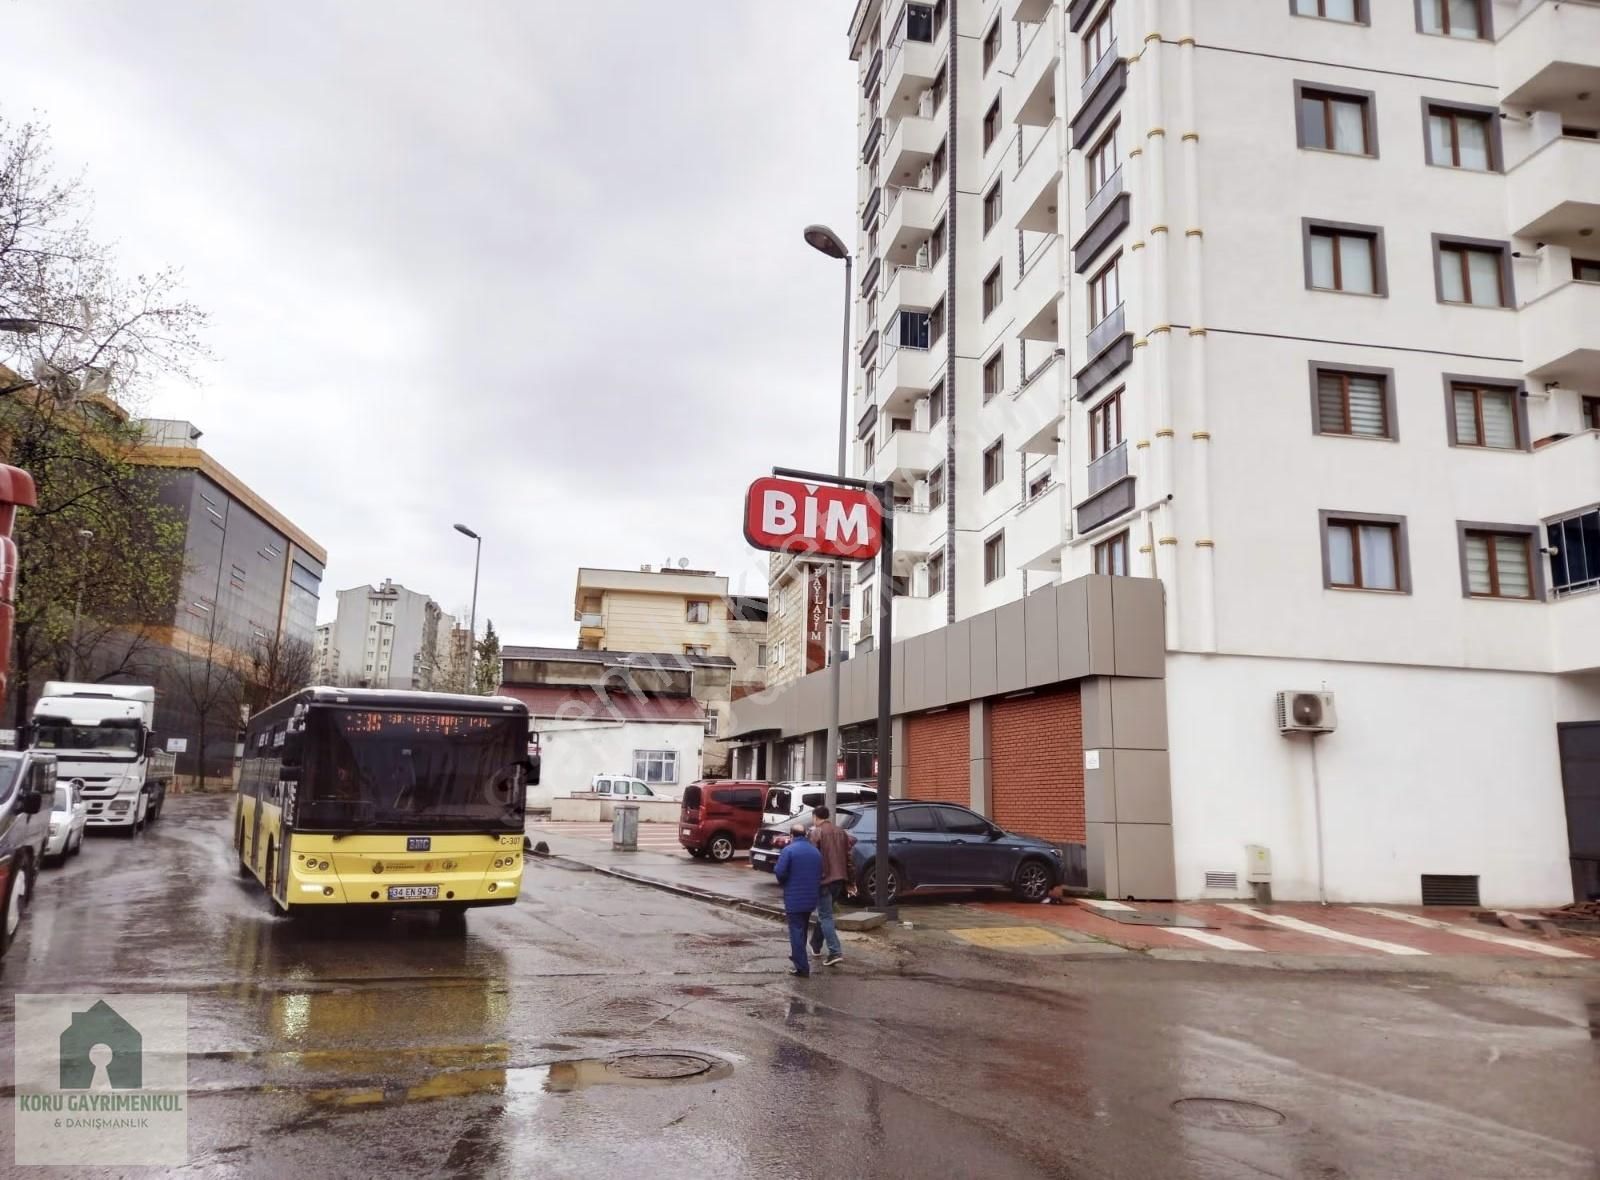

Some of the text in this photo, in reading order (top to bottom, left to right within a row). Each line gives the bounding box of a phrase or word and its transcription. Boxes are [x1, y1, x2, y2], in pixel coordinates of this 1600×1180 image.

[762, 485, 869, 546] BİM
[391, 887, 403, 897] 34
[405, 887, 416, 896] EN
